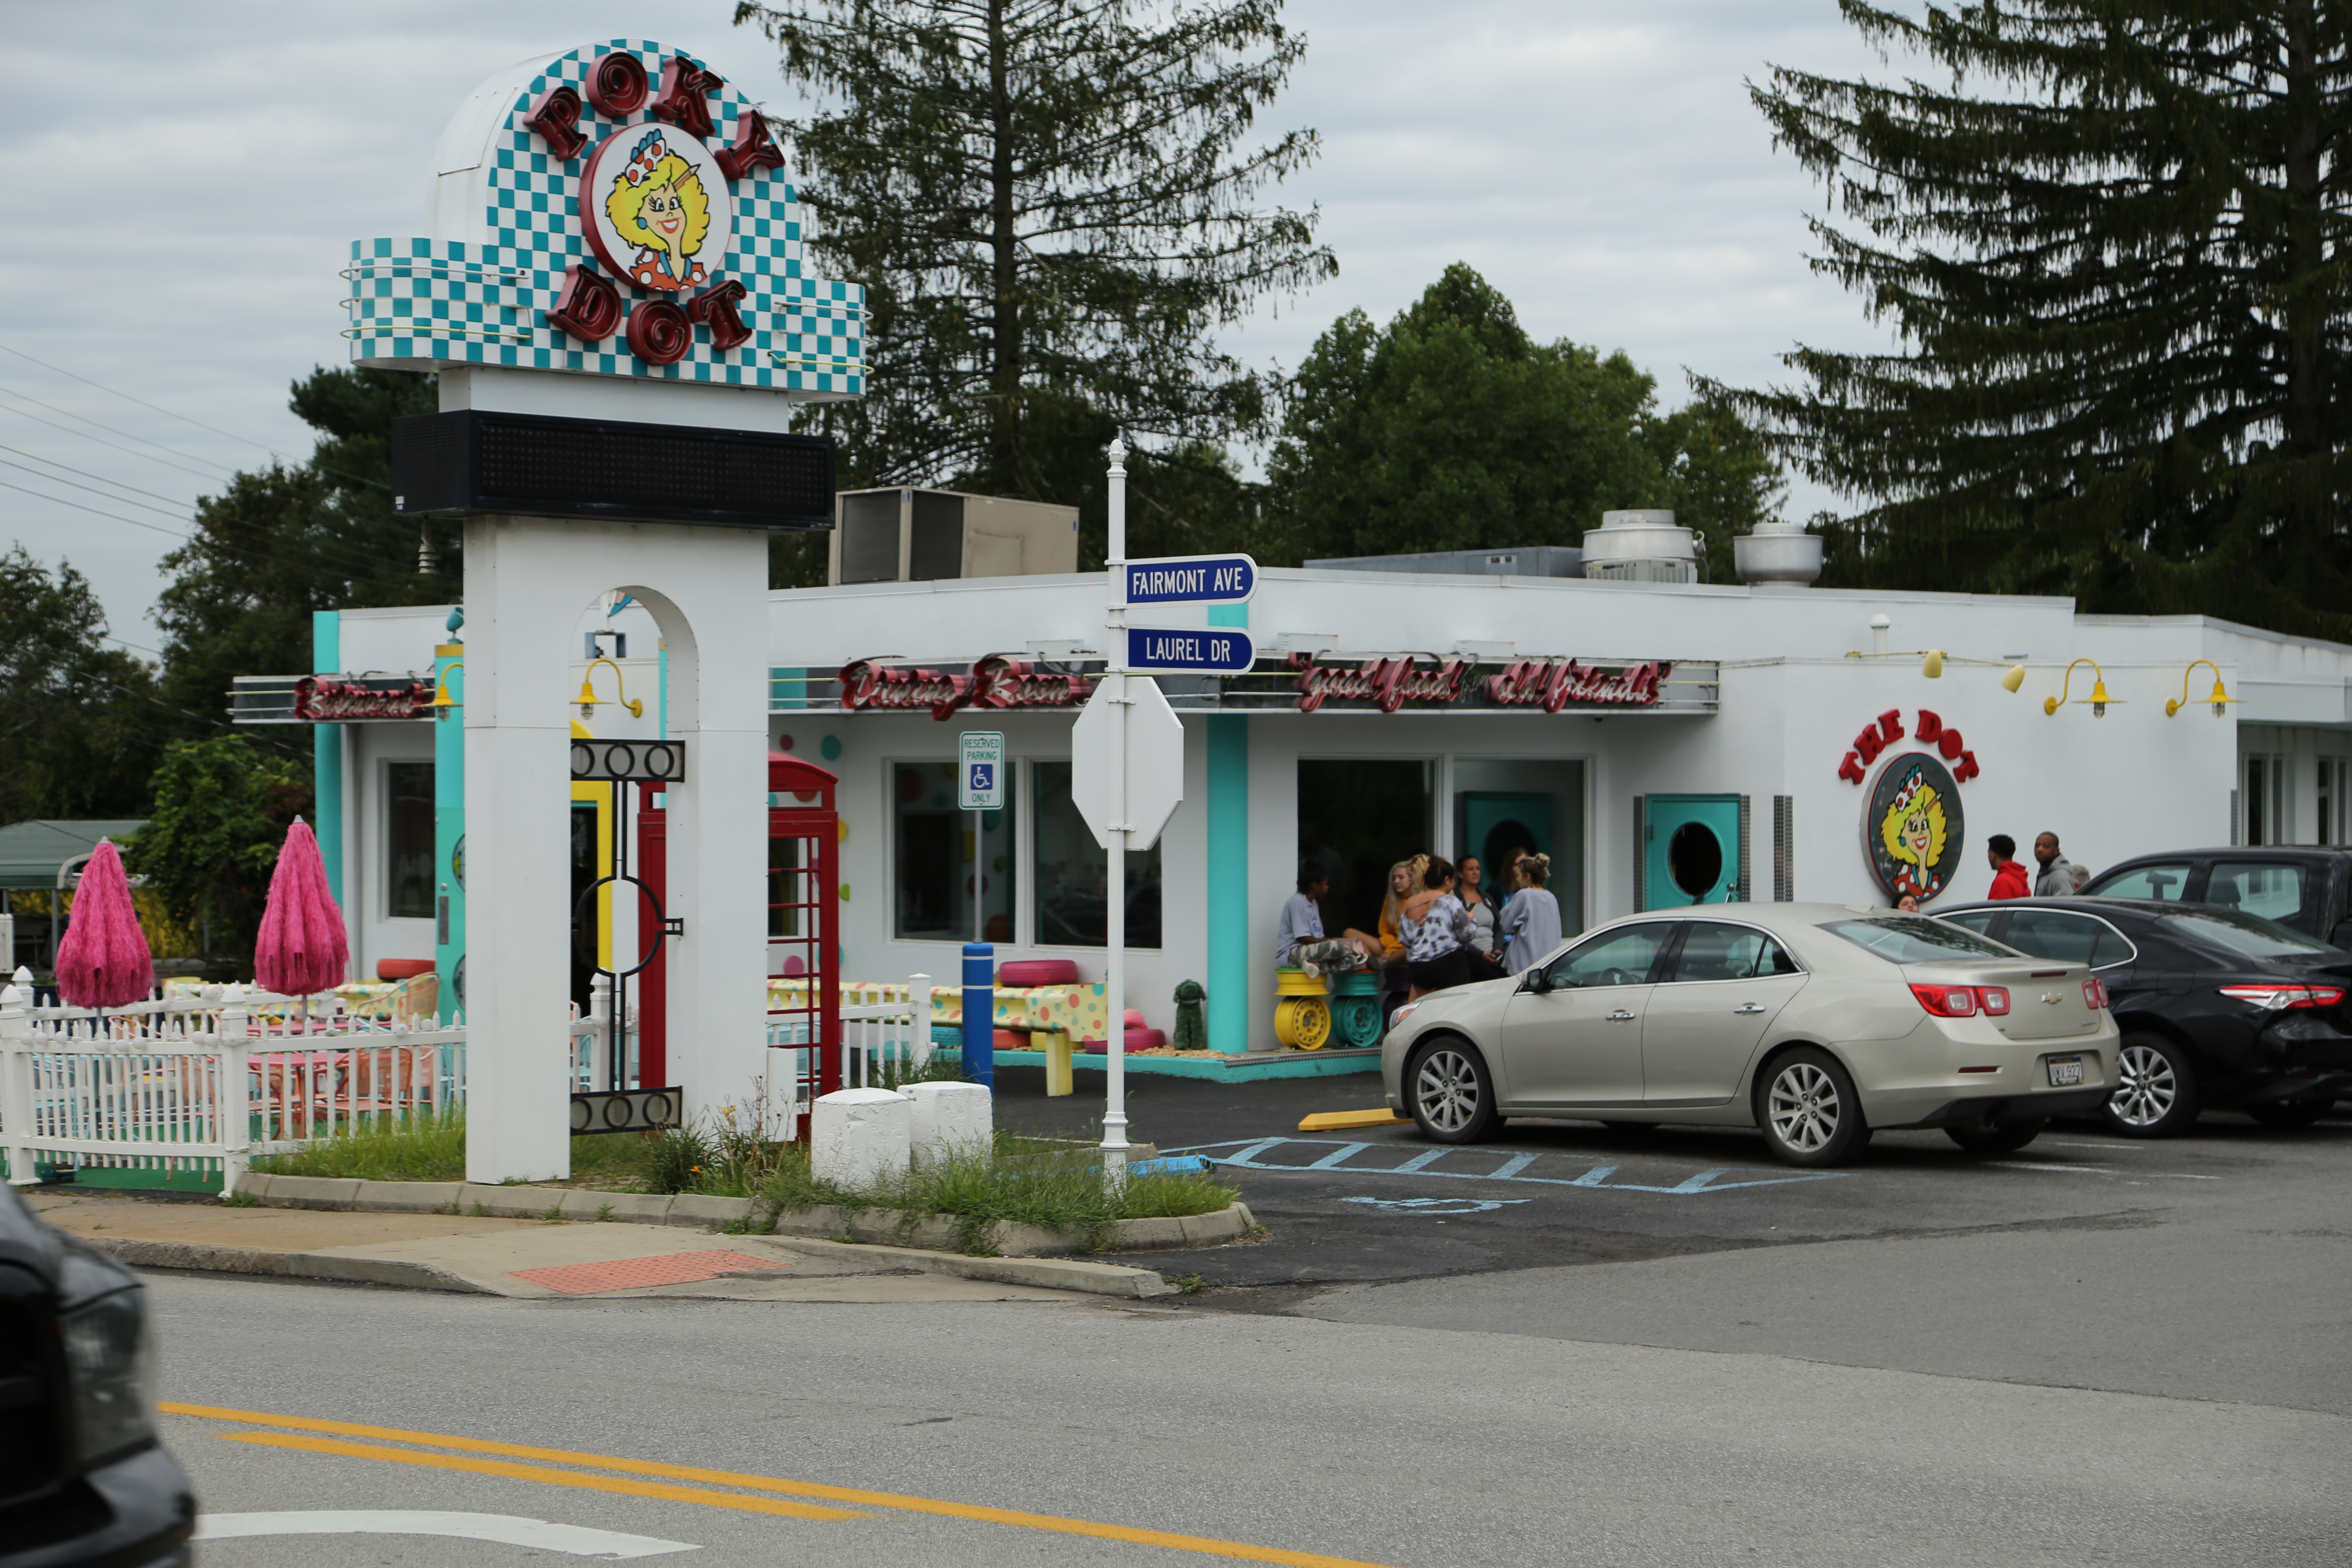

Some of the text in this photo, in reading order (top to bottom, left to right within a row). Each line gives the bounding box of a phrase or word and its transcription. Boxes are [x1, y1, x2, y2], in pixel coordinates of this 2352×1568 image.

[523, 52, 785, 180] POKY
[545, 263, 753, 365] DOT
[1133, 567, 1243, 595] FAIRMONT AVE
[1146, 637, 1231, 662] LAUREL DR
[964, 739, 1000, 748] RESERVED
[967, 751, 997, 760] PARKING
[1838, 708, 1980, 785] THE DOT
[972, 793, 991, 802] ONLY
